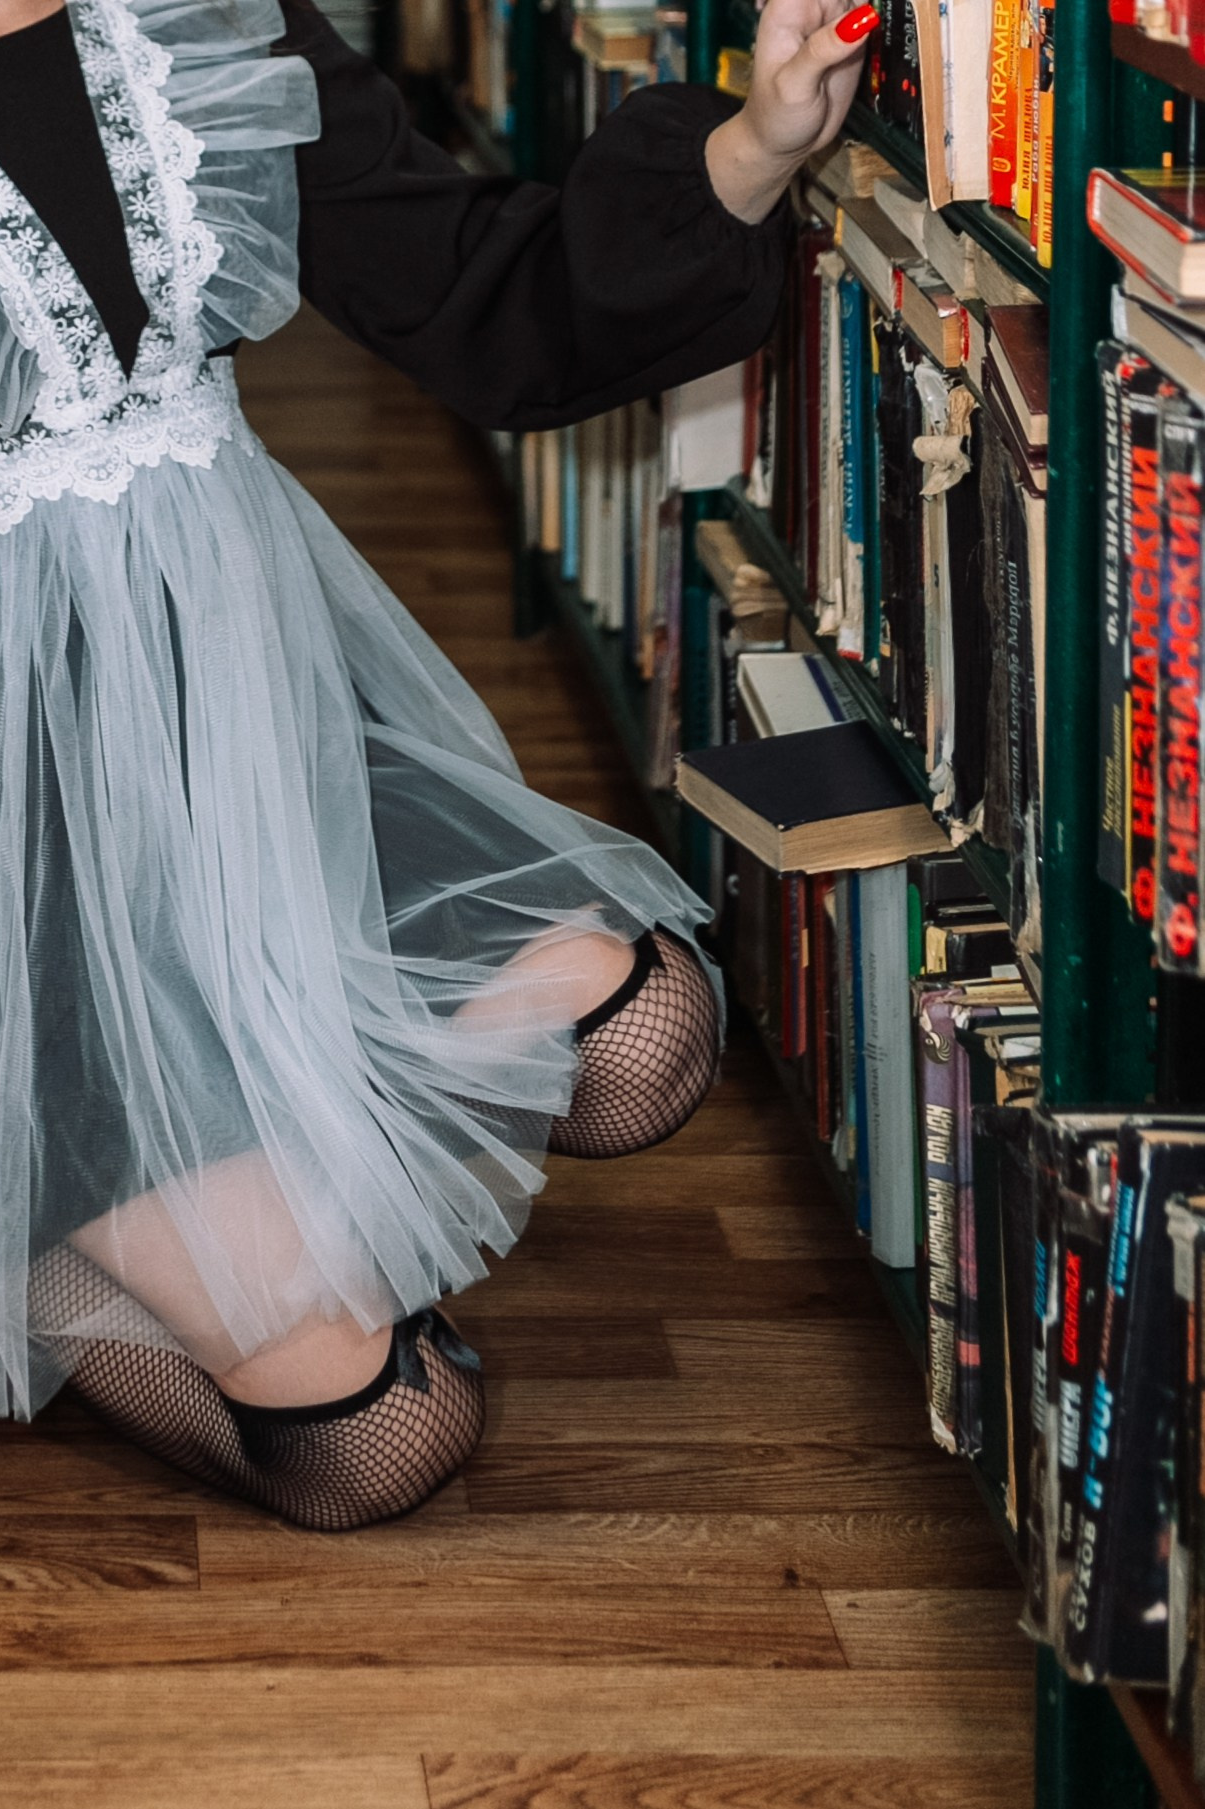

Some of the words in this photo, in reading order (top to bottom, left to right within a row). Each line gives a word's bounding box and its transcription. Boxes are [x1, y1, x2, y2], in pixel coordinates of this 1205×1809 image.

[903, 23, 913, 60] МОЙ
[991, 1, 1010, 104] КРАМЕР
[990, 109, 1006, 139] М.
[1022, 87, 1033, 144] ШИЛОВА
[1022, 150, 1031, 190] ЮЛИЯ
[1031, 136, 1040, 183] Раба
[1043, 134, 1054, 193] ШИЛОВА
[1042, 200, 1053, 244] ЮЛИЯ
[1101, 368, 1121, 609] НЕЗНАНСКИЙ
[1130, 445, 1160, 838] НЕЗНАНСКИЙ
[1165, 471, 1201, 877] НЕЗНАНСКИЙ
[1101, 755, 1116, 832] Частное
[1111, 702, 1125, 840] расследование
[1130, 855, 1156, 920] Ф.
[1164, 892, 1199, 958] Ф.
[925, 1103, 952, 1164] РОМАН
[927, 1177, 955, 1306] КРИМИНАЛЬНЫЙ
[1061, 1250, 1081, 1366] Шантаж
[1059, 1379, 1081, 1470] ОПЕРА
[1074, 1514, 1097, 1633] СУХОВ
